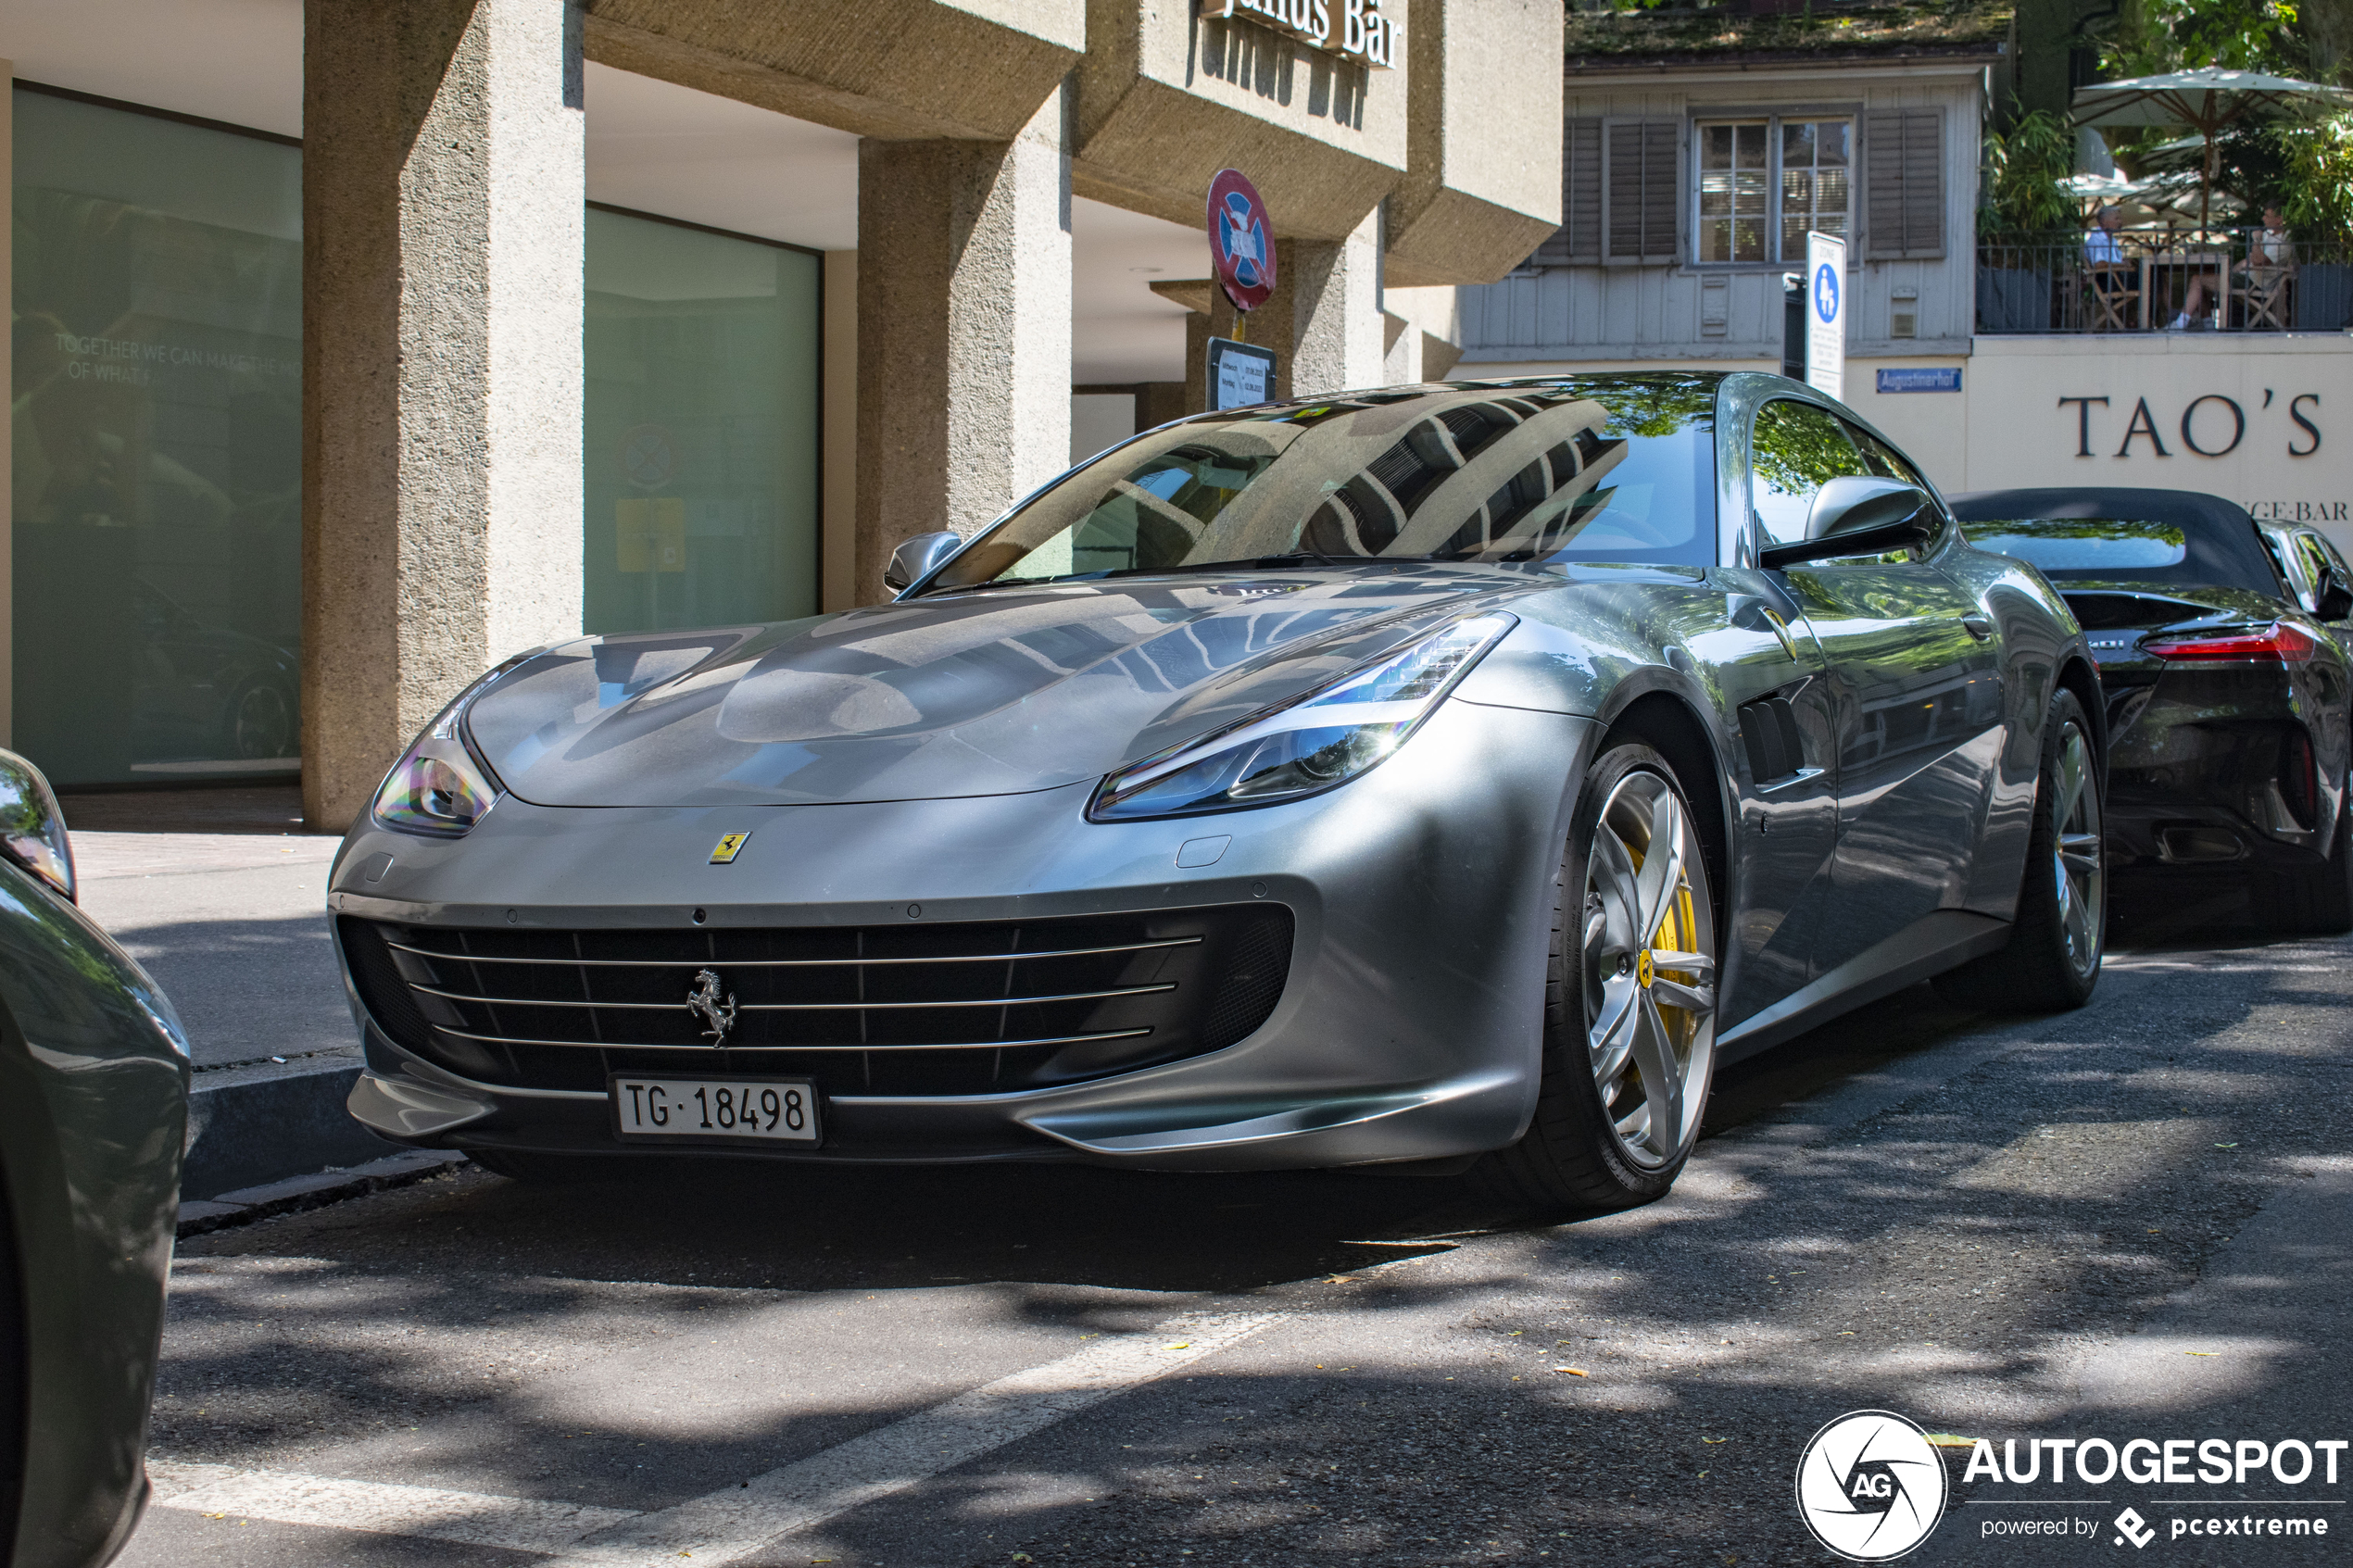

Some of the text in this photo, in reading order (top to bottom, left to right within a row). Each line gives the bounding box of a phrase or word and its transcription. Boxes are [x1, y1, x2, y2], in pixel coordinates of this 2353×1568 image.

[1820, 245, 1835, 261] ZONE
[55, 332, 139, 360] TOGETHER
[144, 345, 167, 364] WE
[170, 346, 202, 367] CAN
[206, 350, 245, 371] MAKE
[249, 355, 276, 376] THE
[69, 360, 90, 380] OF
[94, 363, 140, 383] WHAT
[1881, 370, 1956, 392] Augustinerhof
